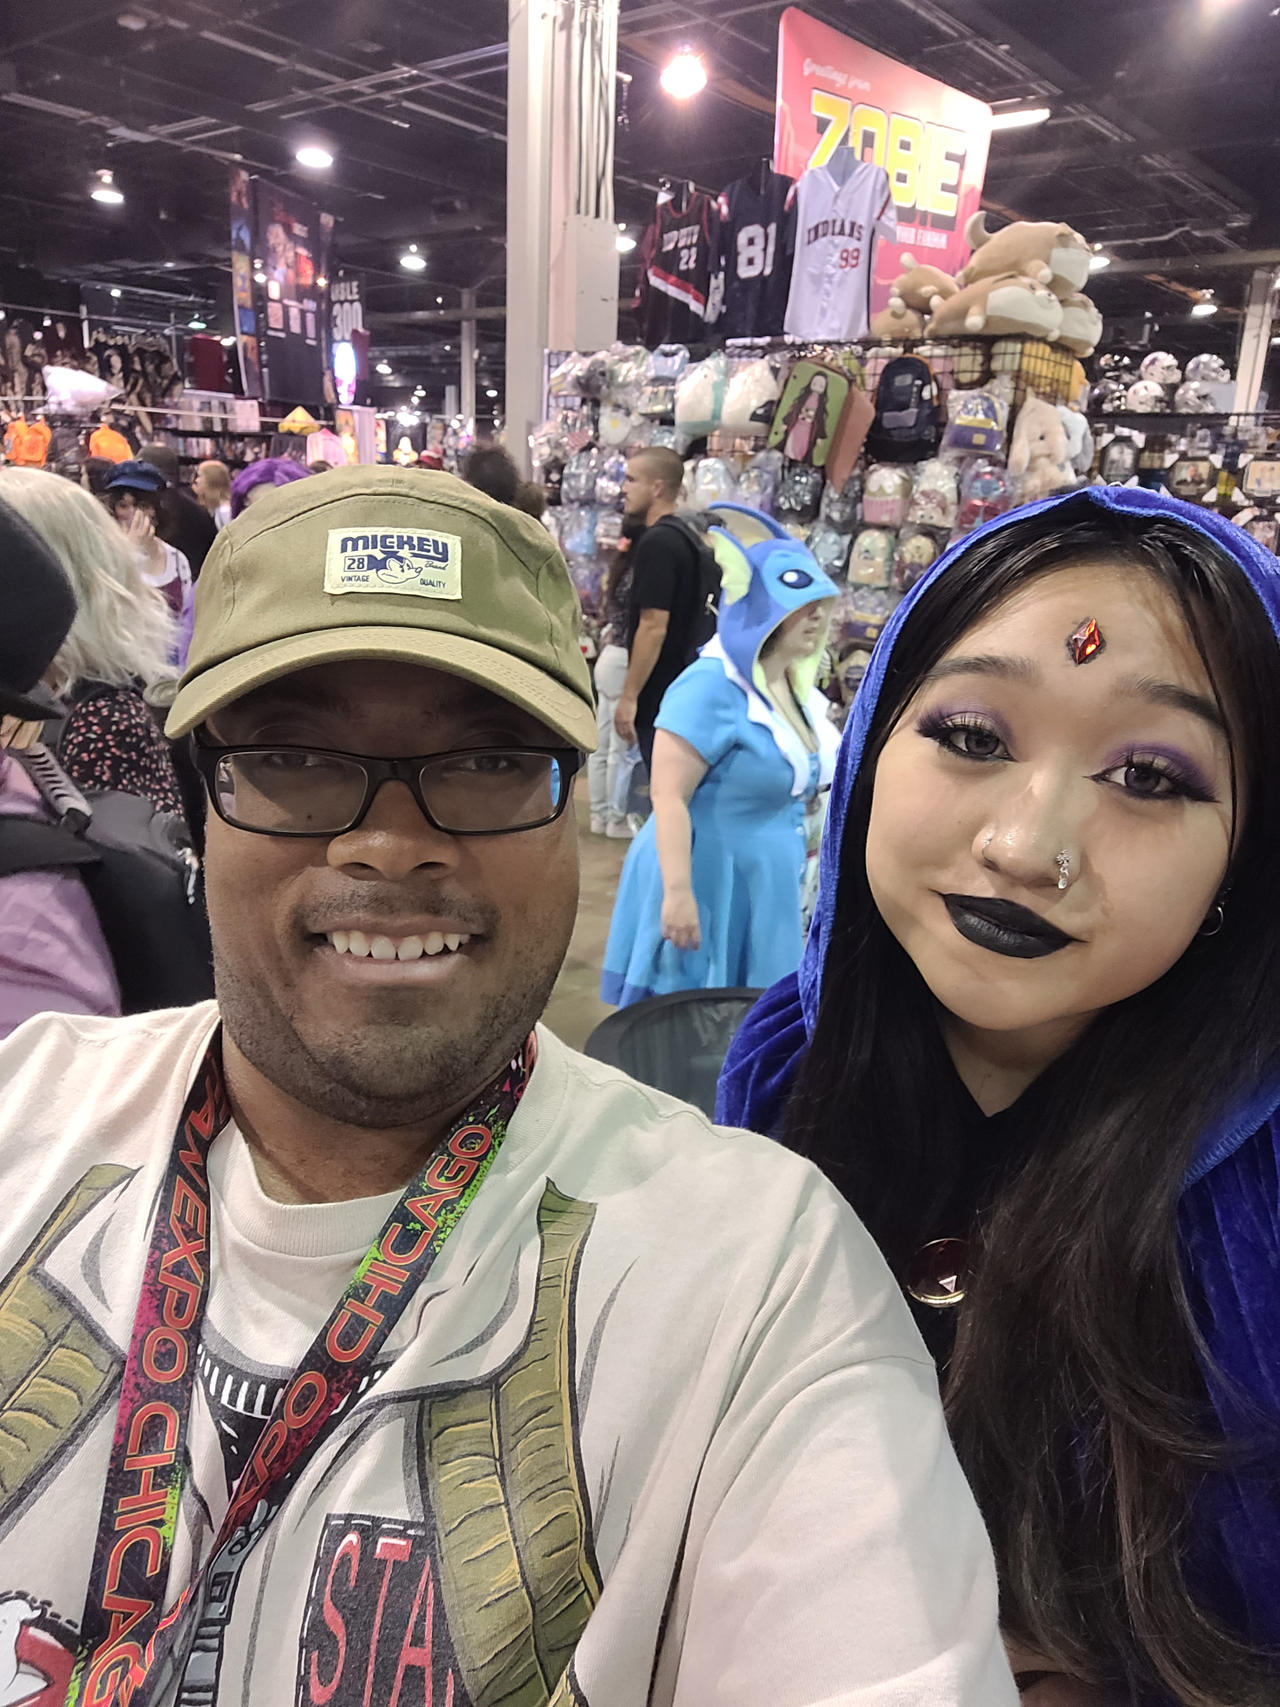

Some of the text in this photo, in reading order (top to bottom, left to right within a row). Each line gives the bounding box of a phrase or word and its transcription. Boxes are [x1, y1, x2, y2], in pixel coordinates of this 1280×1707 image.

[807, 219, 863, 245] INDIANS
[737, 222, 777, 279] 81
[839, 248, 861, 269] 99
[333, 302, 362, 341] 300
[340, 534, 449, 563] MICKEY
[347, 557, 365, 570] 28
[341, 575, 369, 583] VINTAGE
[420, 578, 446, 588] QUALITY
[325, 1124, 493, 1363] CHICAGO
[309, 1531, 454, 1707] STA
